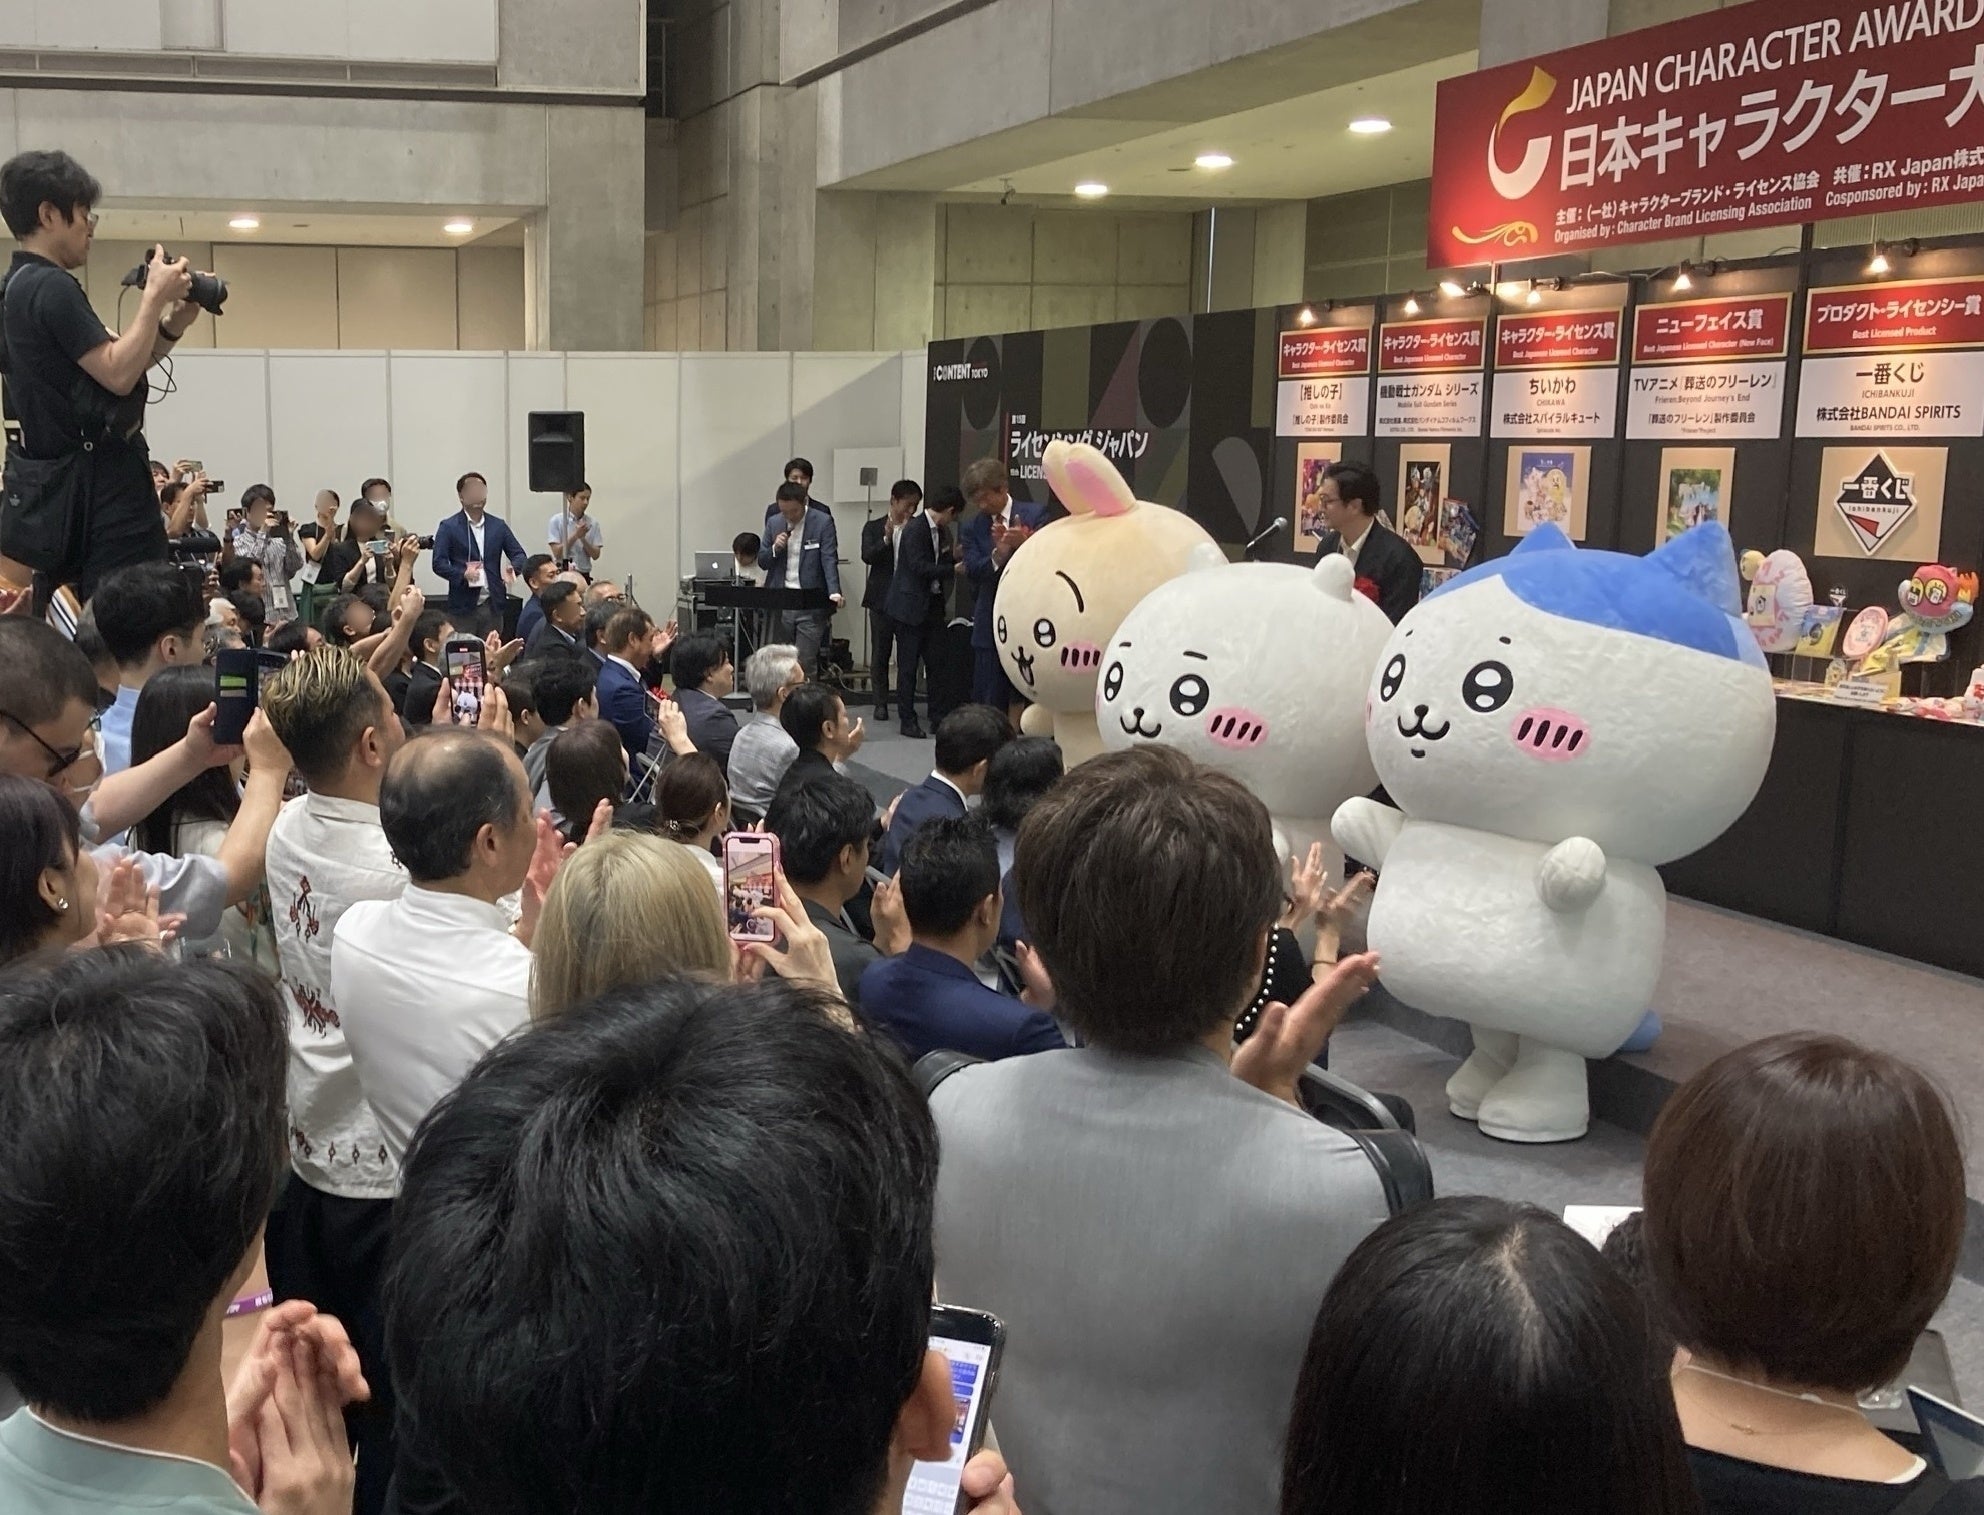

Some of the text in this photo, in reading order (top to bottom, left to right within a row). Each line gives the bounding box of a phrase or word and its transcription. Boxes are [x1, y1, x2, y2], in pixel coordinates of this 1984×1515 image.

[1566, 62, 1648, 114] JAPAN
[1654, 18, 1841, 93] CHARACTER
[1555, 224, 1597, 245] Organised
[1617, 216, 1661, 235] Character
[1664, 211, 1693, 228] Brand
[1695, 205, 1745, 223] Licensing
[1748, 196, 1812, 217] Association
[1825, 182, 1903, 207] Cosponsored
[1931, 175, 1950, 193] RX
[1817, 294, 1982, 324] プロダクト・ライセンシー賞
[1656, 308, 1764, 334] ニューフェイス賞
[1852, 330, 1869, 339] Best
[1905, 325, 1937, 337] Product
[936, 363, 972, 381] CONTENT
[971, 367, 989, 379] TOKYO
[1856, 362, 1925, 385] 一番くじ
[1380, 381, 1479, 399] 機動戦士ガンダム シリーズ
[1529, 377, 1576, 395] ちいかわ
[1861, 388, 1915, 399] ICHIBANKUJI
[1503, 412, 1600, 425] 株式会社スパイラルキュート
[1816, 404, 1961, 422] 株式会社BANDAI SPIRITS
[1096, 429, 1149, 459] ジャパン
[1843, 476, 1909, 499] 一番くじ
